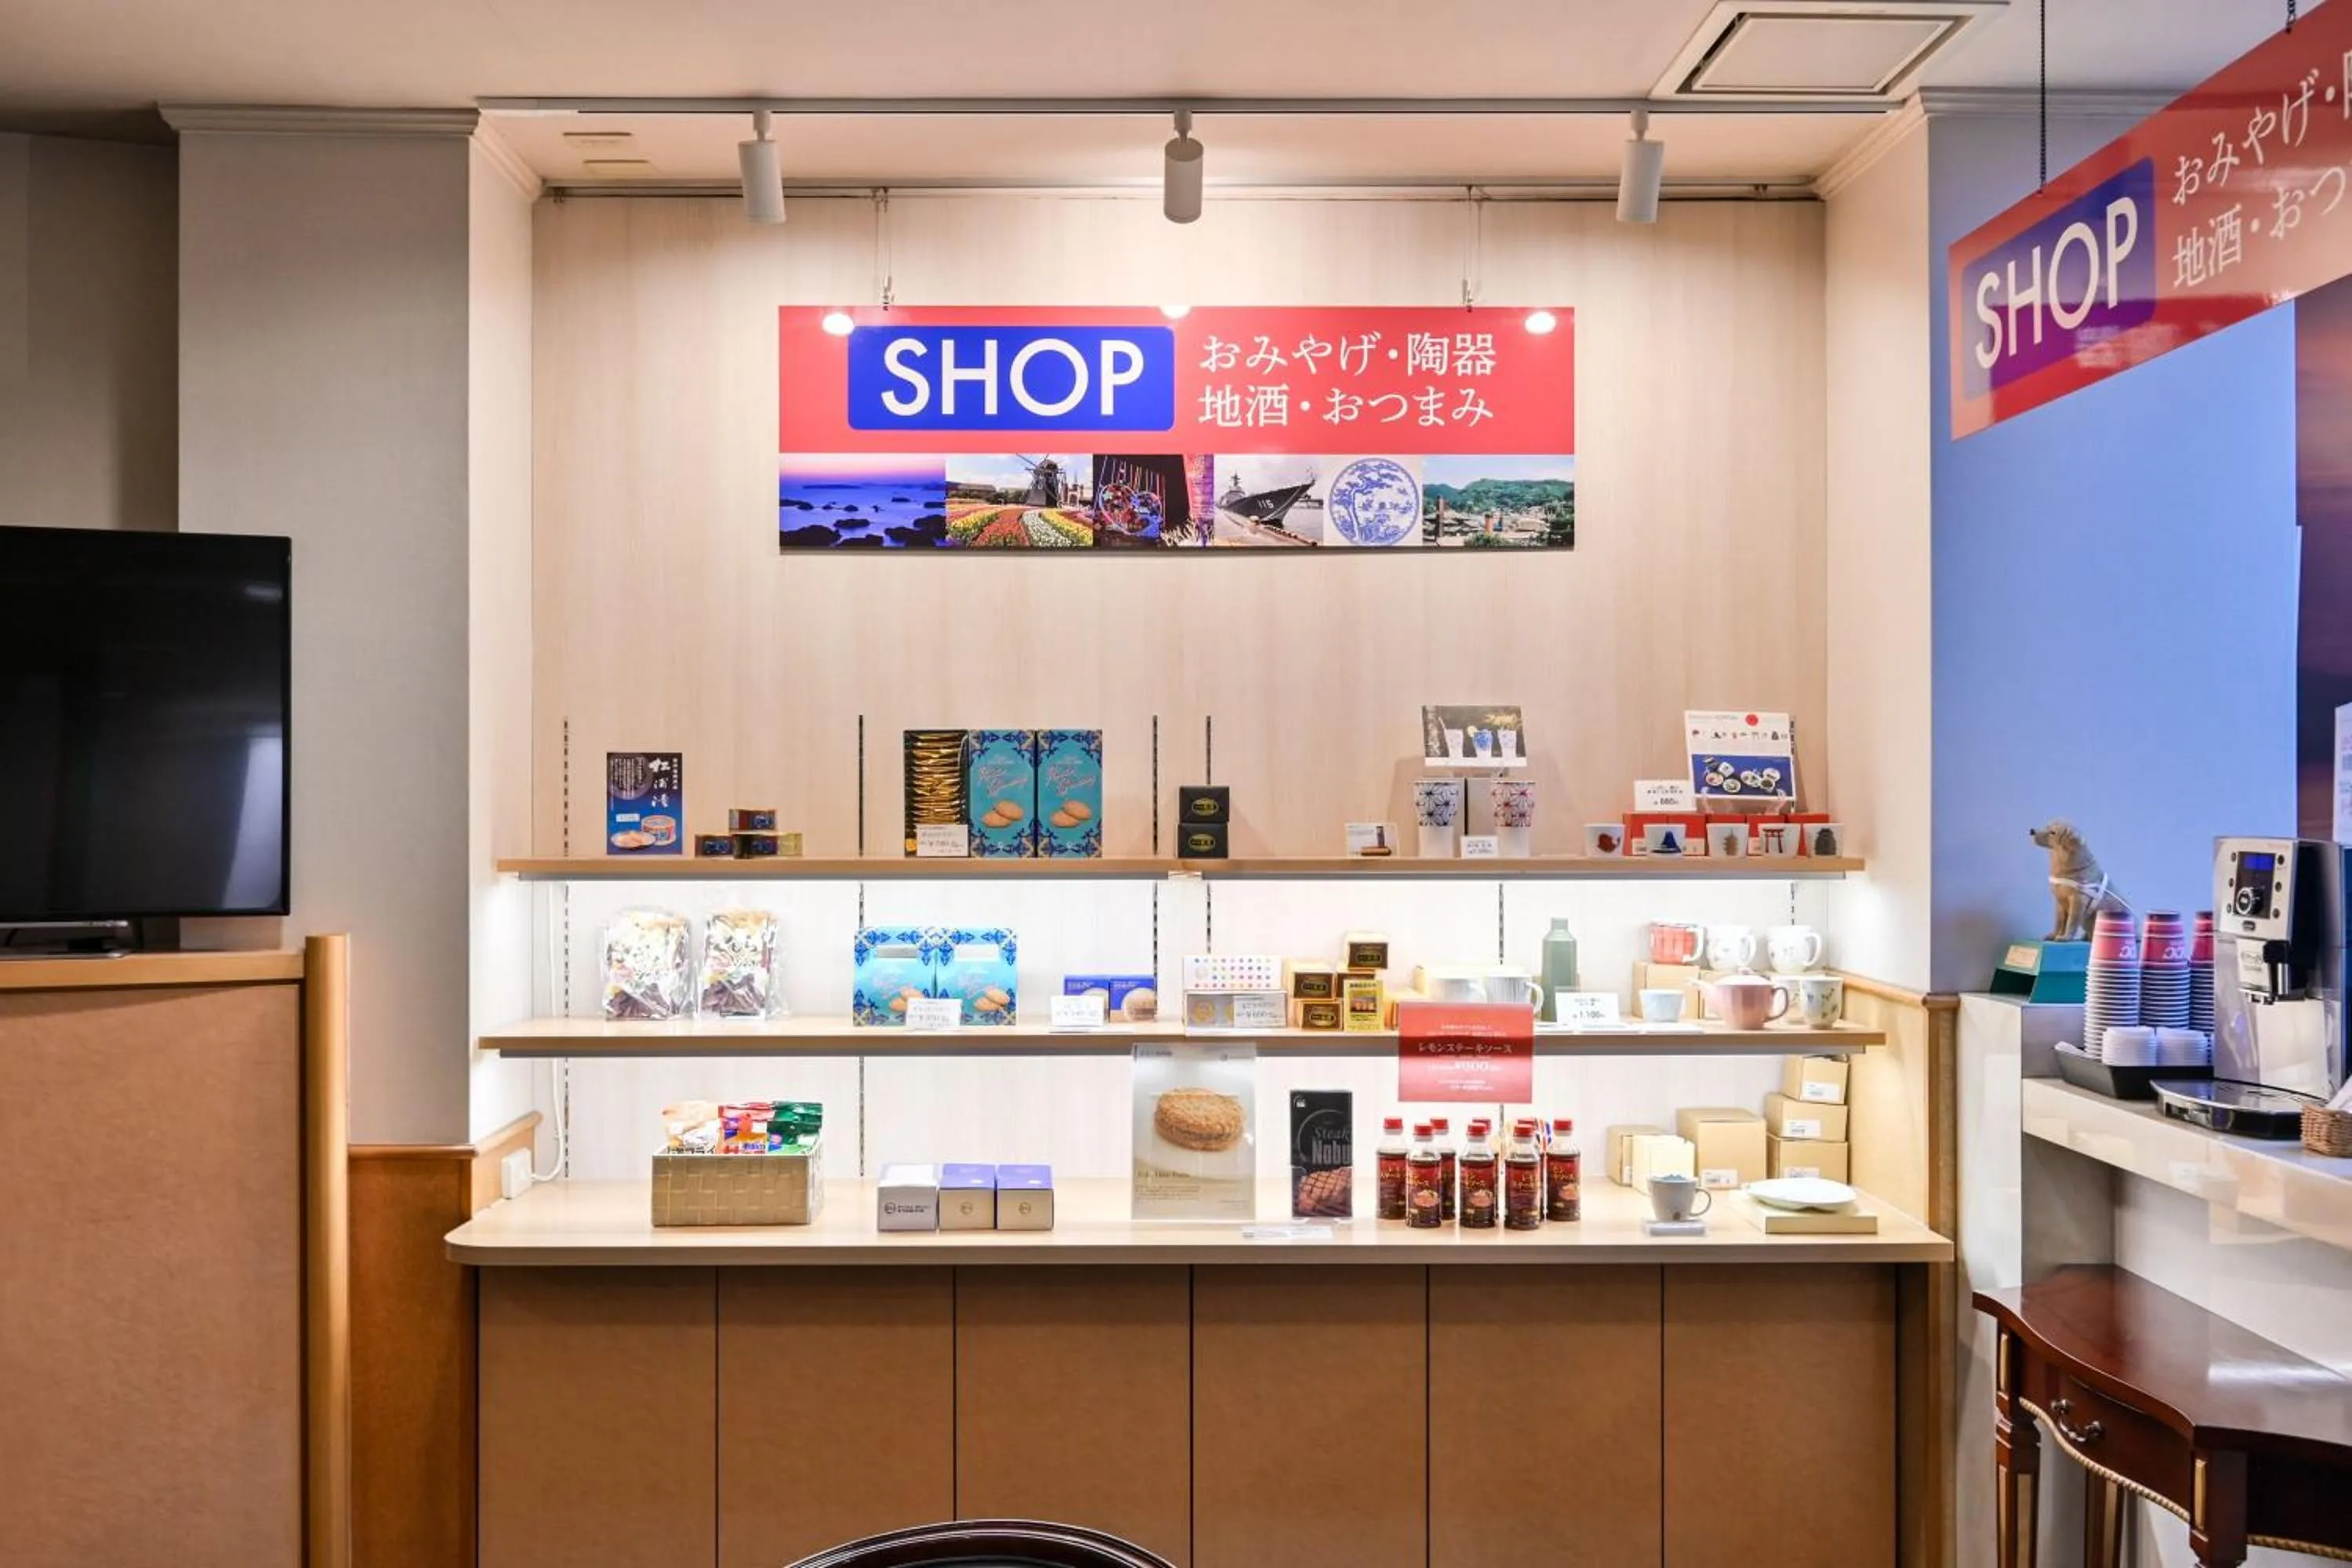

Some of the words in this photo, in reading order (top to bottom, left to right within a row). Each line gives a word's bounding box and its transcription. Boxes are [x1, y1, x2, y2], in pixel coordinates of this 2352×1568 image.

[1975, 197, 2138, 368] SHOP
[1198, 331, 1497, 376] おみやげ・陶器
[881, 338, 1144, 416] SHOP
[1198, 383, 1494, 427] 地酒・おつまみ
[1417, 1042, 1512, 1054] レモンステーキソース
